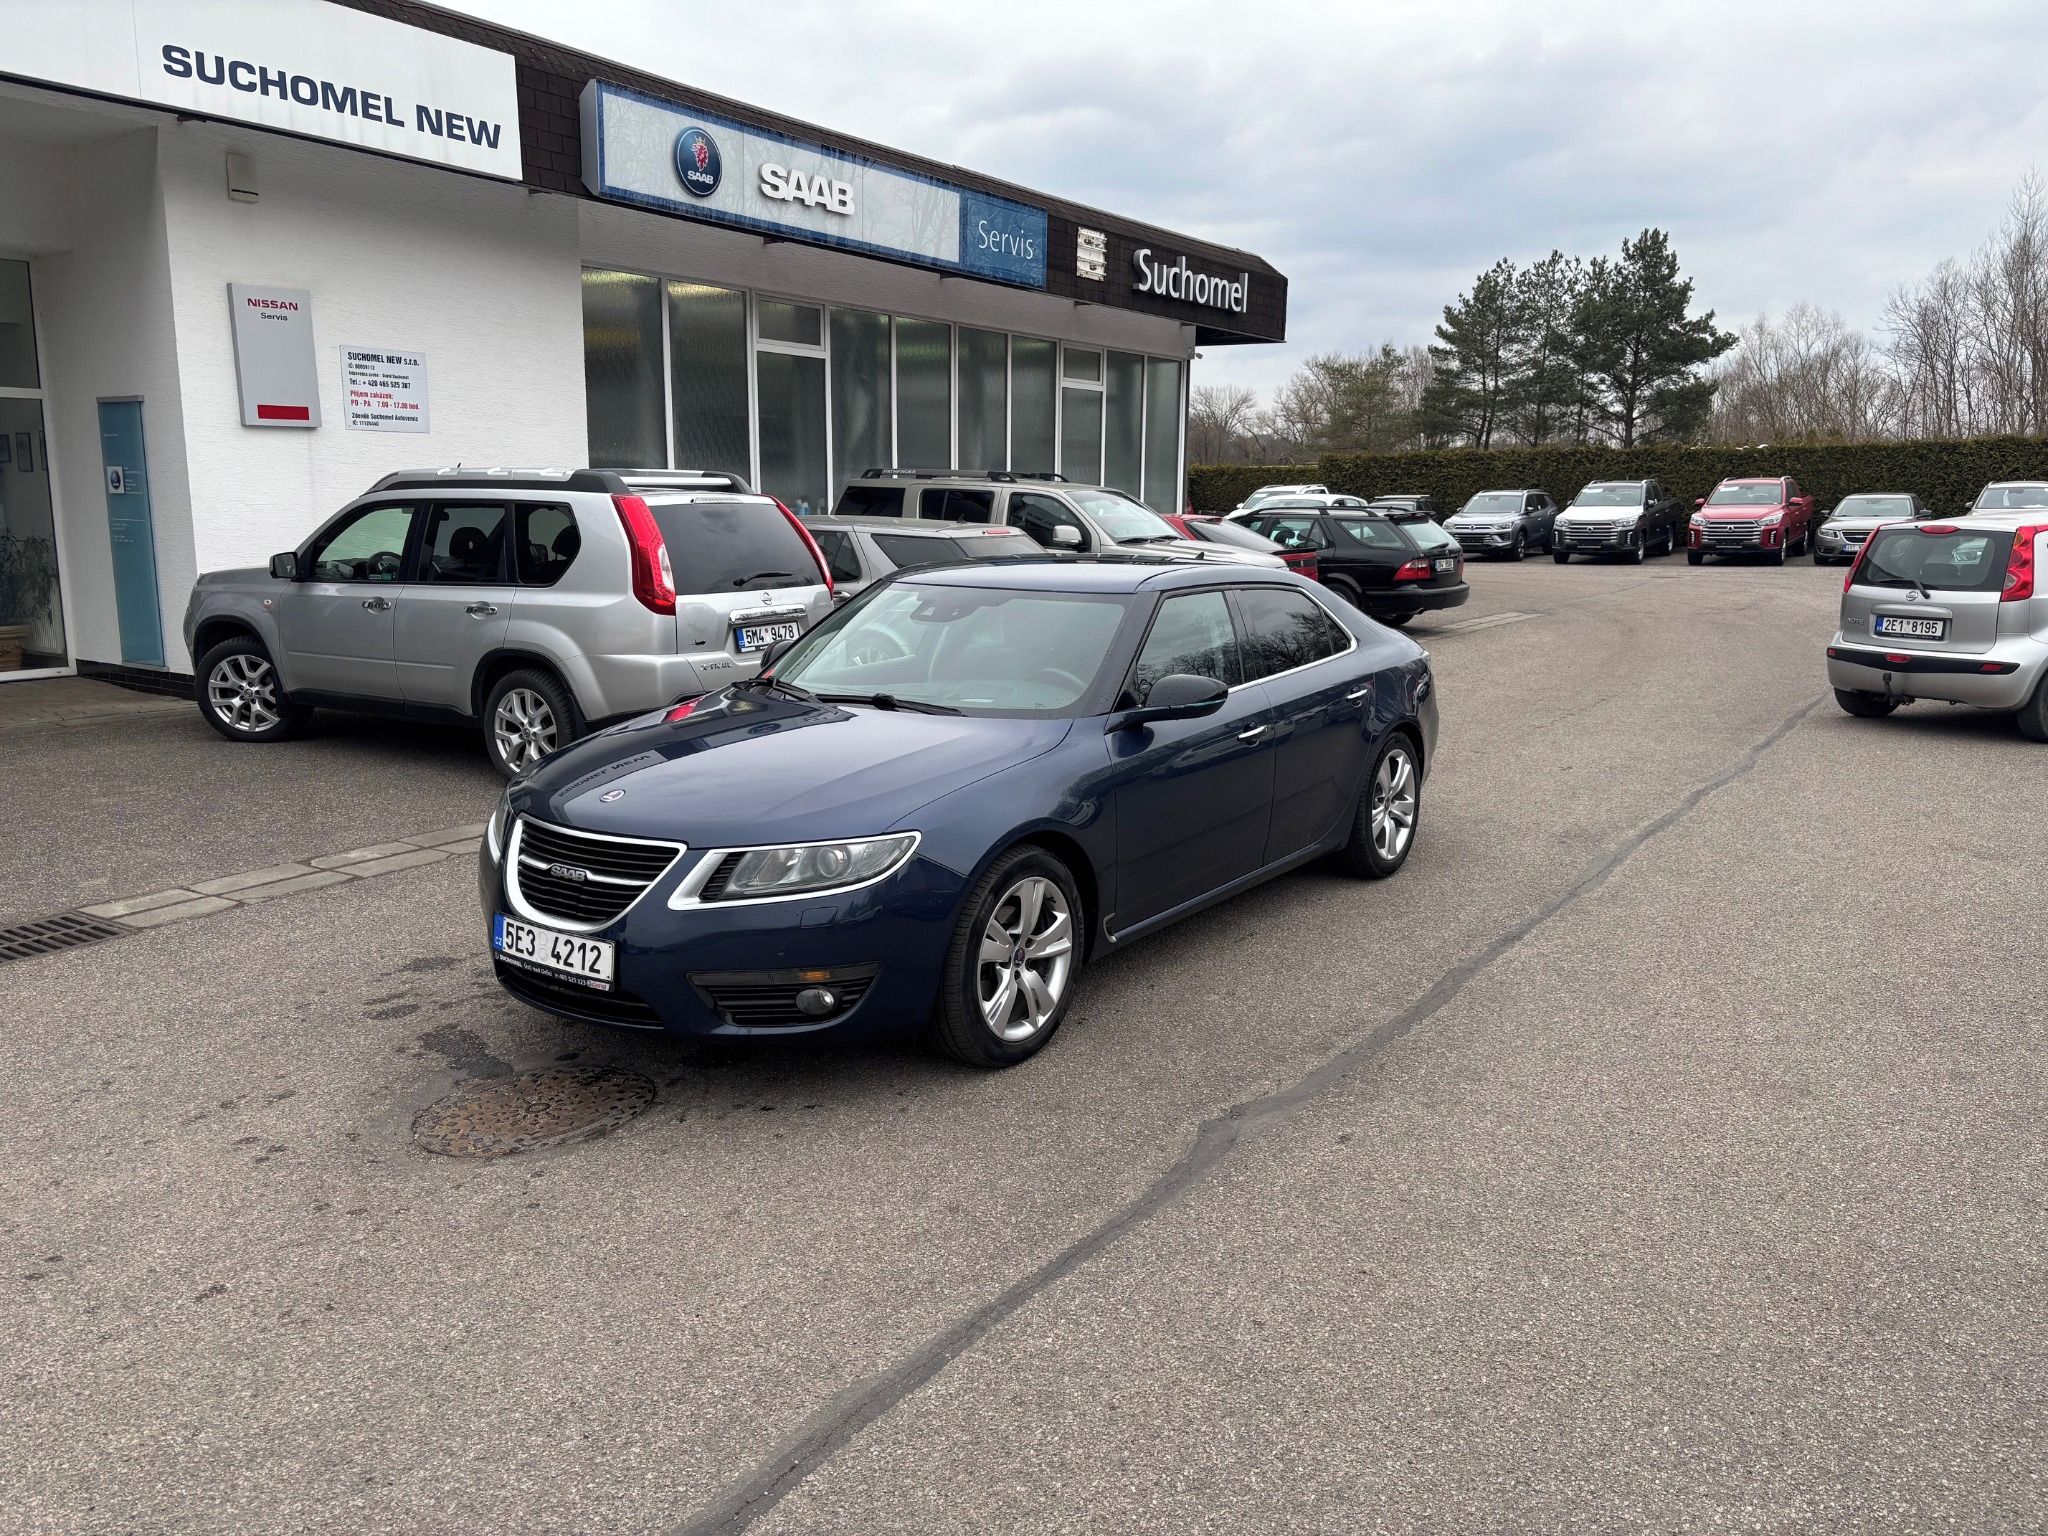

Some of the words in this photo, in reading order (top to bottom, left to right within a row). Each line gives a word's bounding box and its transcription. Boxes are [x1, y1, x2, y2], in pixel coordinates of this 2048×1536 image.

[162, 44, 405, 127] SUCHOMEL
[415, 104, 501, 149] NEW
[687, 170, 714, 185] SAAB
[760, 162, 855, 215] SAAB
[978, 220, 1034, 260] Servis
[1134, 248, 1249, 313] Suchomel
[247, 298, 299, 311] NISSAN
[260, 312, 288, 321] Servis
[347, 351, 385, 364] SUCHOMEL
[386, 355, 402, 365] NEW
[403, 358, 420, 367] s.r.o.
[349, 377, 361, 386] Tel.:
[367, 379, 378, 388] 420
[378, 380, 390, 389] 465
[390, 380, 401, 389] 525
[351, 399, 359, 407] PO
[1884, 619, 1904, 632] 2E1
[1911, 620, 1939, 634] 8195
[745, 628, 765, 645] 5M4
[770, 625, 795, 641] 9478
[550, 865, 586, 882] SAAB
[505, 921, 536, 957] 5E3
[550, 936, 602, 975] 4212
